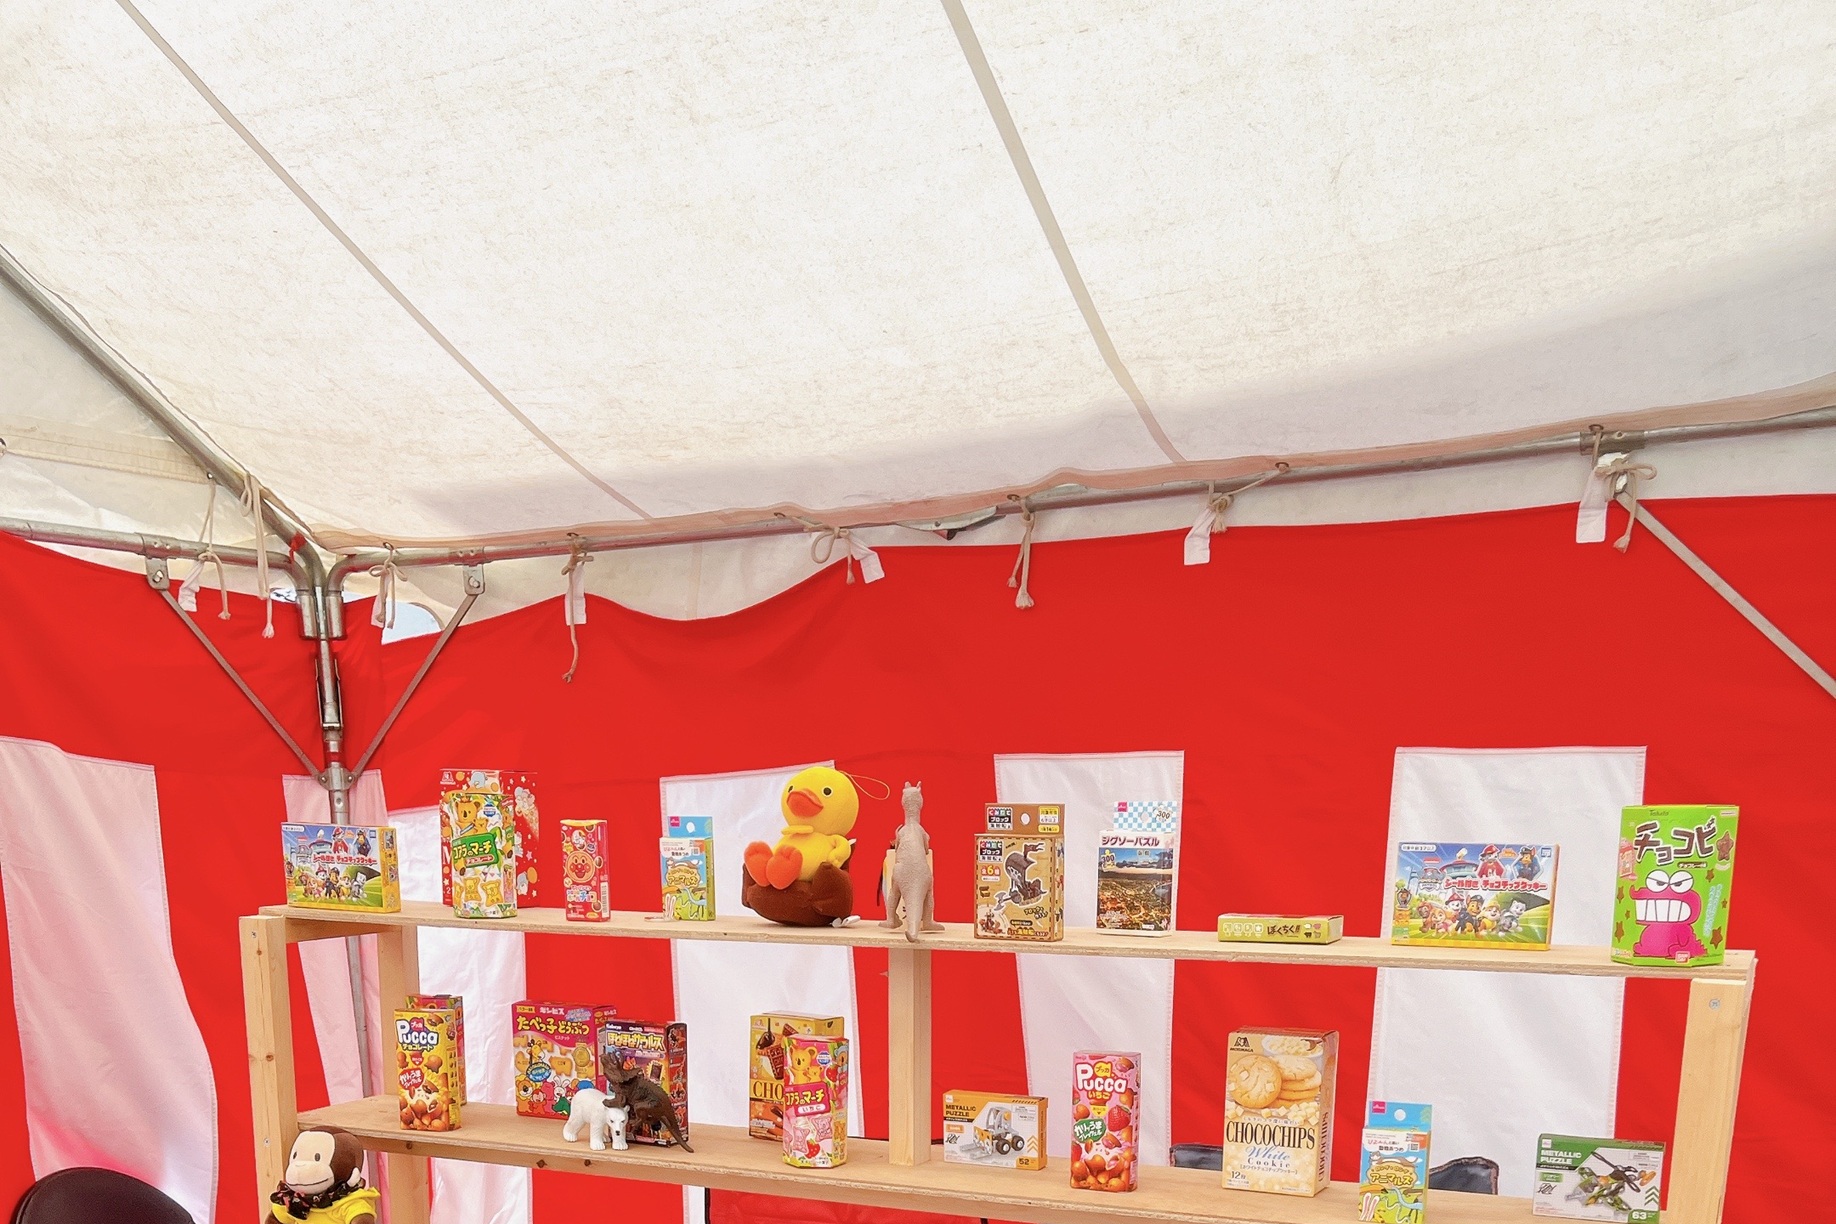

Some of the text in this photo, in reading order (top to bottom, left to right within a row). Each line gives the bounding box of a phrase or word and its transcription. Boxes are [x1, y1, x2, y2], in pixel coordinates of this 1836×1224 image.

[1101, 836, 1160, 847] ジグソーパズル
[1633, 816, 1718, 865] チョコビ
[453, 840, 492, 859] コアラのマーチ
[1481, 879, 1548, 891] チョコチップクッキー
[396, 1019, 439, 1045] Pucca
[516, 1015, 590, 1036] たべっ子どうぶつ
[1075, 1063, 1128, 1094] Pucca
[785, 1088, 825, 1106] コアラのマーチ
[945, 1104, 977, 1112] METALLIC
[1226, 1120, 1316, 1150] CHOCOCHIPS
[1246, 1144, 1291, 1161] White
[1540, 1149, 1582, 1158] METALLIC
[1247, 1157, 1291, 1168] Cookie
[1540, 1156, 1573, 1165] PUZZLE
[1370, 1172, 1413, 1186] アニマルズ
[1631, 1211, 1647, 1220] 63
